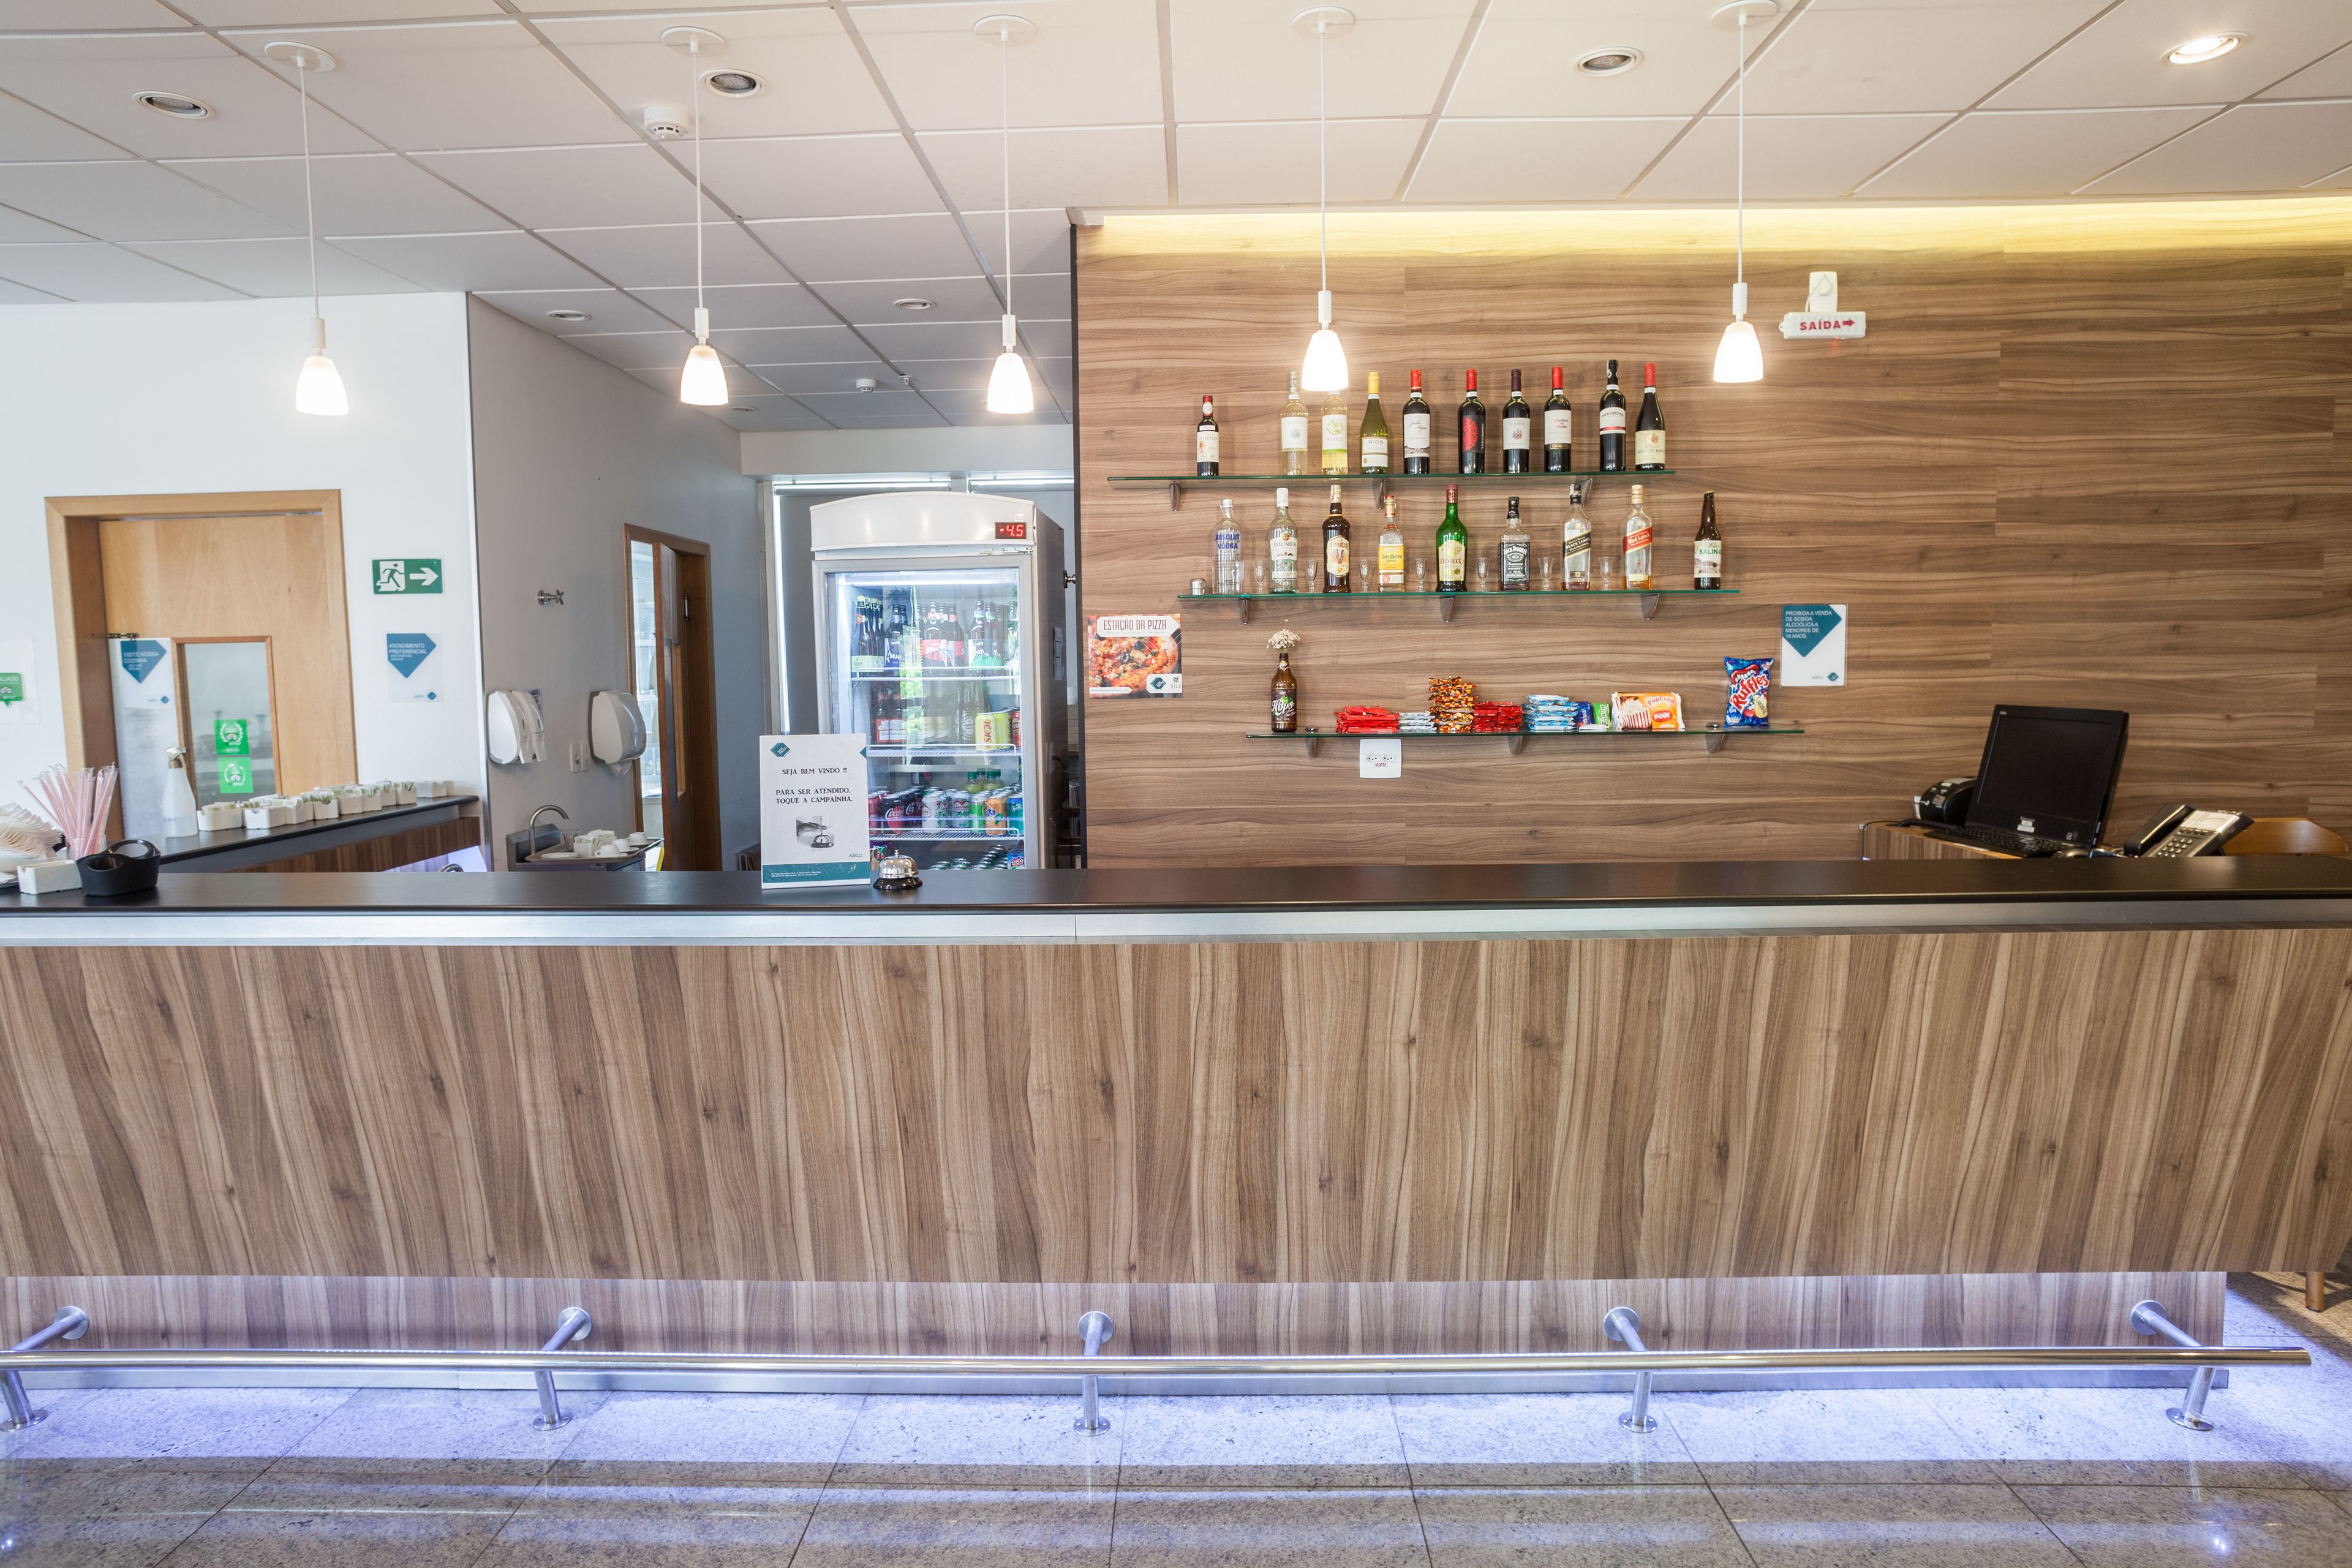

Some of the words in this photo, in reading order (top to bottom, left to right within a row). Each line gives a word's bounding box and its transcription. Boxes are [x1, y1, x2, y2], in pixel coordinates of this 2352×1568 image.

[1800, 318, 1841, 331] SAÍDA
[1000, 524, 1023, 536] -4.5
[1103, 617, 1133, 631] ESTAÇÃO
[1136, 620, 1145, 630] DA
[1148, 619, 1166, 630] PIZZA
[1730, 674, 1770, 712] Ruffles
[1272, 699, 1293, 716] Hops
[1647, 696, 1675, 705] PopCorn
[984, 720, 993, 743] SKOL
